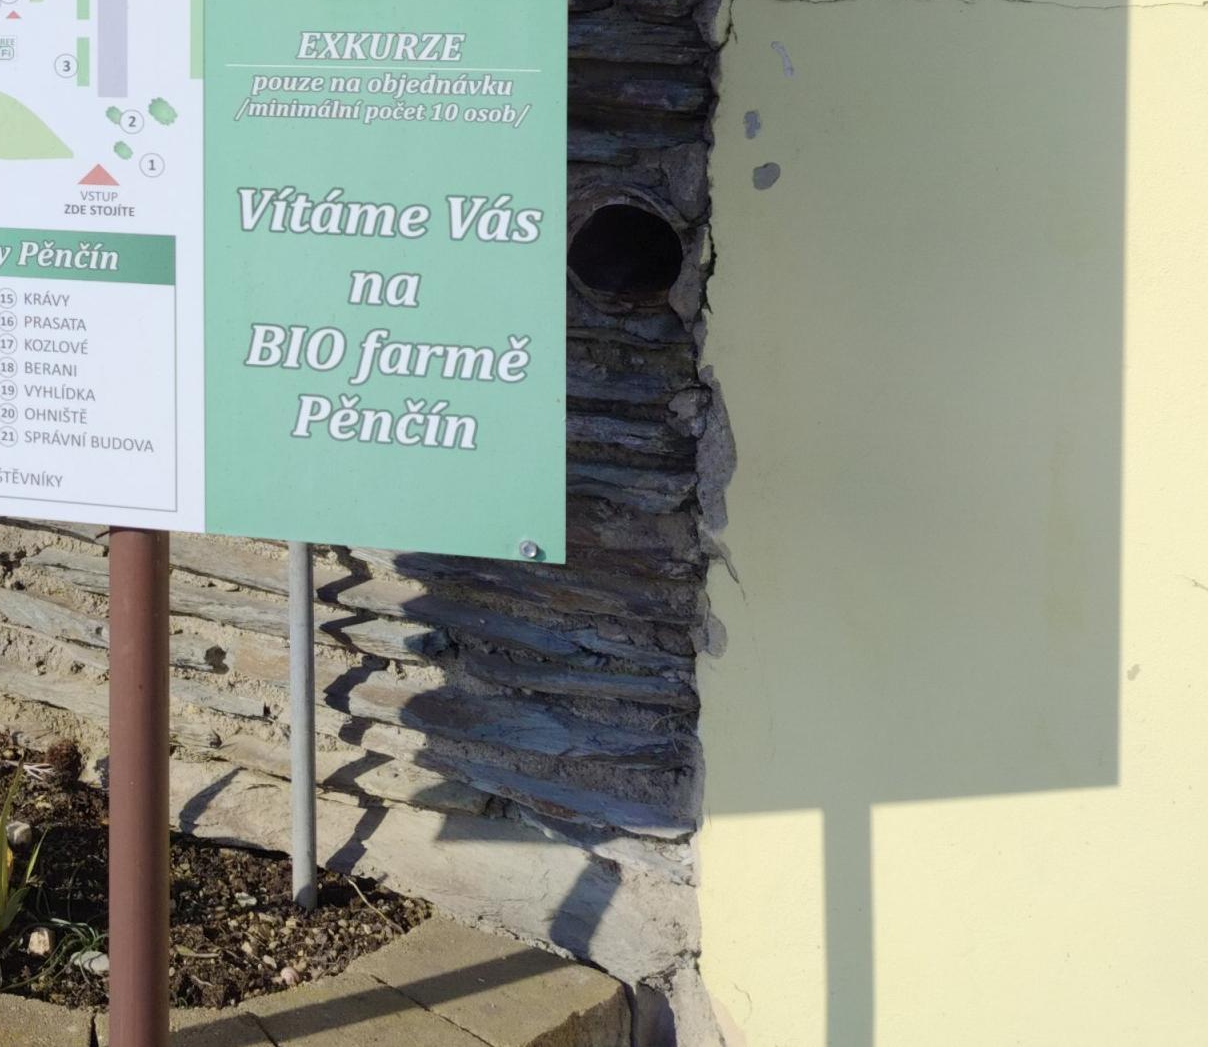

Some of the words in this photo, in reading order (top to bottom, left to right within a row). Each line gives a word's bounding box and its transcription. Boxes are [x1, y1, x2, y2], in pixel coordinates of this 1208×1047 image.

[297, 31, 466, 63] EXKURZE
[252, 74, 324, 96] pouze
[329, 75, 361, 95] na
[366, 71, 514, 100] objednávku
[364, 102, 427, 125] počet
[430, 104, 459, 122] 10
[80, 191, 118, 202] VSTUP
[64, 204, 87, 216] ZDE
[89, 203, 135, 217] STOJÍTE
[236, 187, 430, 239] Vítáme
[447, 194, 544, 244] Vás
[17, 240, 119, 270] Pěnčín
[0, 293, 14, 304] 15
[24, 291, 70, 307] KRÁVY
[347, 269, 422, 309] na
[0, 317, 14, 327] 16
[24, 317, 86, 331] PRASATA
[0, 339, 14, 350] 17
[24, 338, 88, 354] KOZLOVÉ
[245, 324, 347, 373] BIO
[348, 328, 532, 385] farmě
[1, 362, 15, 373] 18
[24, 362, 77, 377] BERANI
[1, 385, 15, 396] 19
[24, 382, 96, 401] VYHLÍDKA
[1, 408, 15, 419] 20
[24, 406, 87, 424] OHNIŠTĚ
[291, 394, 478, 451] Pěnčín
[1, 431, 15, 442] 21
[24, 428, 86, 447] SPRÁVNÍ
[91, 435, 154, 453] BUDOVA
